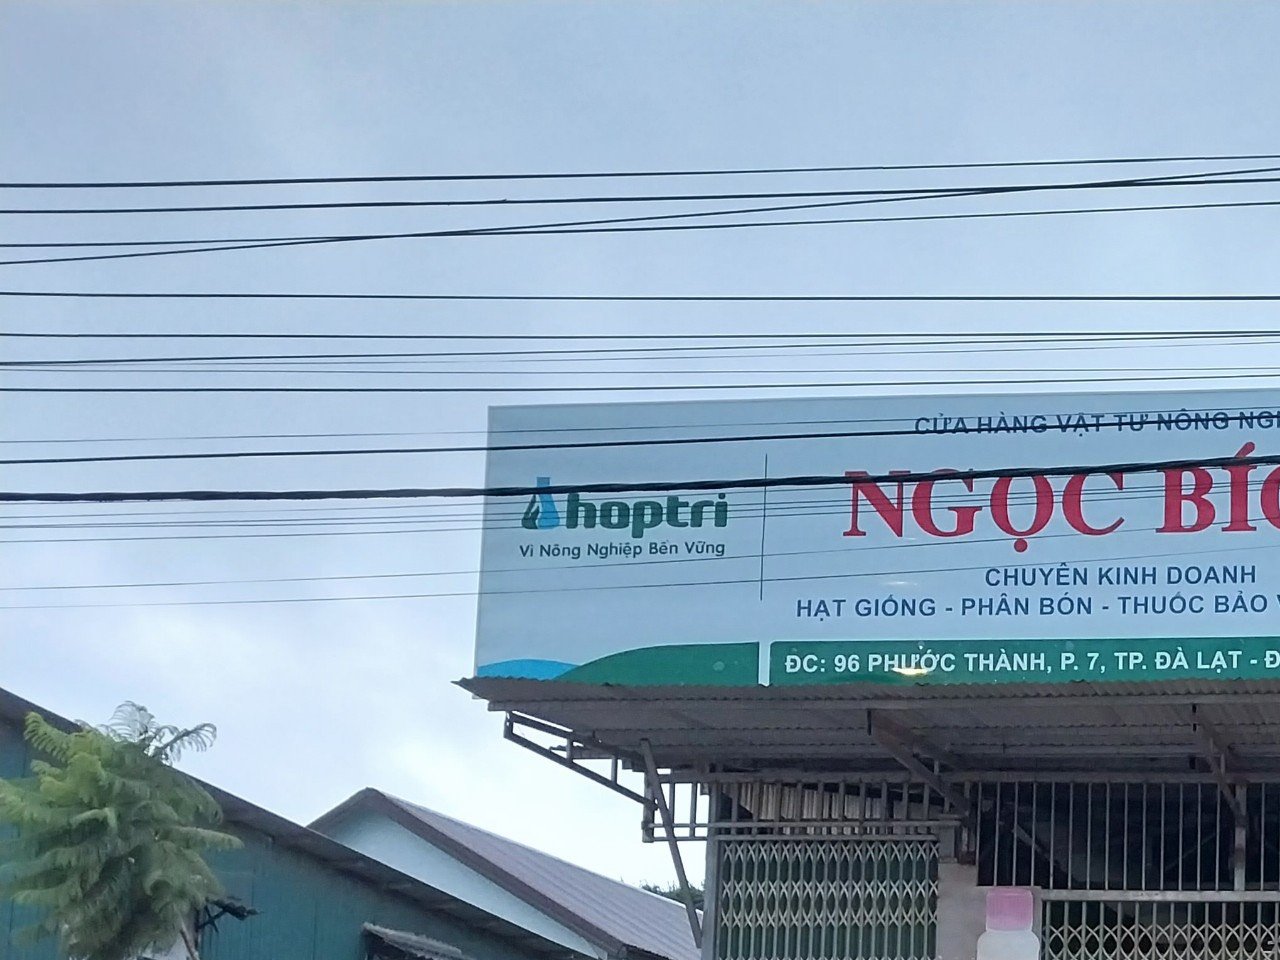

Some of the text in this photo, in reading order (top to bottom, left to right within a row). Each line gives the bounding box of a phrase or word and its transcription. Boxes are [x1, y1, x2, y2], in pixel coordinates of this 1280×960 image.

[915, 413, 969, 434] CỬA
[977, 411, 1047, 434] HÀNG
[1056, 412, 1105, 437] VẬT
[1113, 414, 1149, 431] TƯ
[1157, 408, 1229, 431] NÔNG
[566, 492, 728, 538] hoptri
[843, 468, 1125, 553] NGỌC
[519, 540, 725, 559] Vì Nông Nghiệp Bền Vững
[985, 561, 1257, 586] CHUYÊN KINH DOANH
[796, 599, 846, 621] HẠT
[855, 593, 936, 617] GIỐNG
[961, 593, 1029, 616] PHÂN
[1039, 592, 1092, 615] BÓN
[1118, 591, 1204, 614] THUỐC
[1214, 590, 1268, 613] BẢO
[785, 654, 826, 674] ĐC:
[834, 653, 860, 673] 96
[868, 649, 956, 674] PHƯỚC
[964, 649, 1052, 674] THÀNH,
[1061, 652, 1079, 671] P.
[1087, 652, 1105, 674] 7,
[1114, 651, 1147, 671] TP.
[1154, 646, 1189, 671] ĐÀ
[1197, 650, 1242, 674] LẠT
